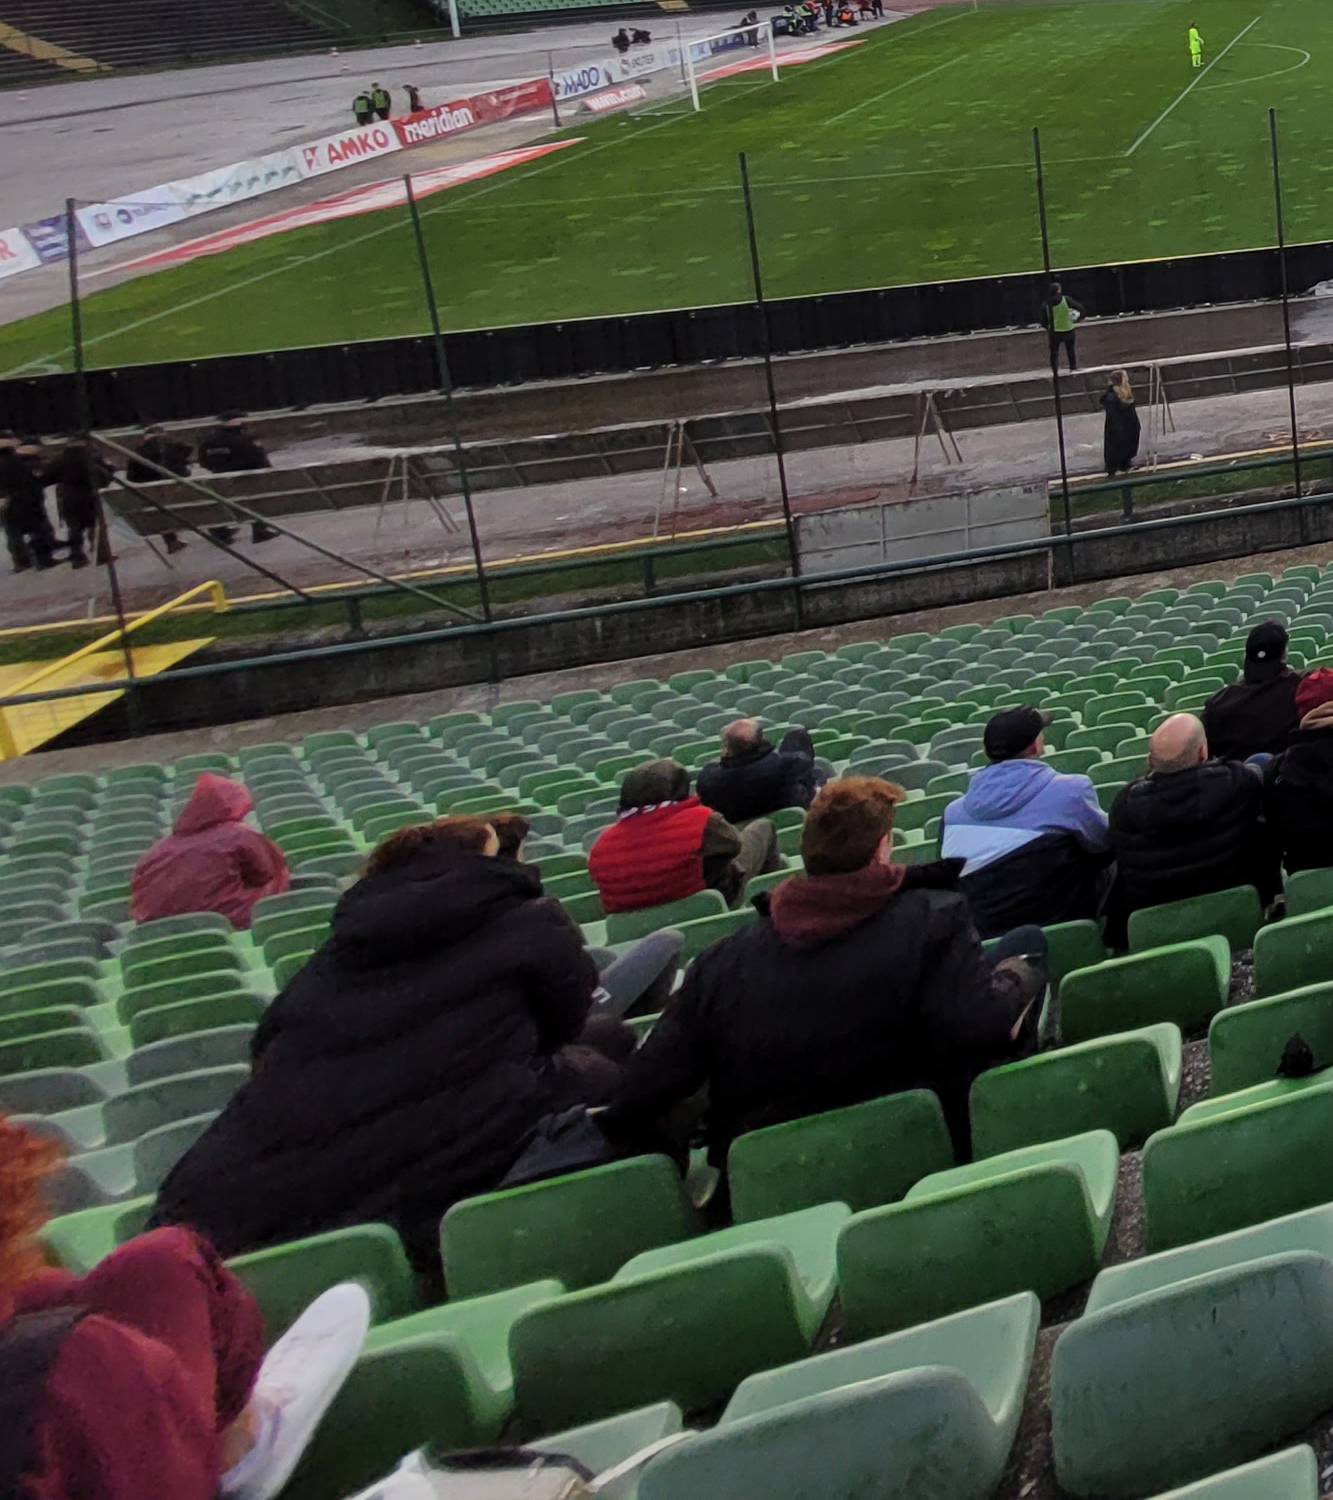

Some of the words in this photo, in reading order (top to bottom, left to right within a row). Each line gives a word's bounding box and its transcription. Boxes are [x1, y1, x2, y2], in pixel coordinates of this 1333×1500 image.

[563, 66, 600, 94] MADO
[403, 104, 475, 144] meridian
[328, 128, 390, 165] AMKO
